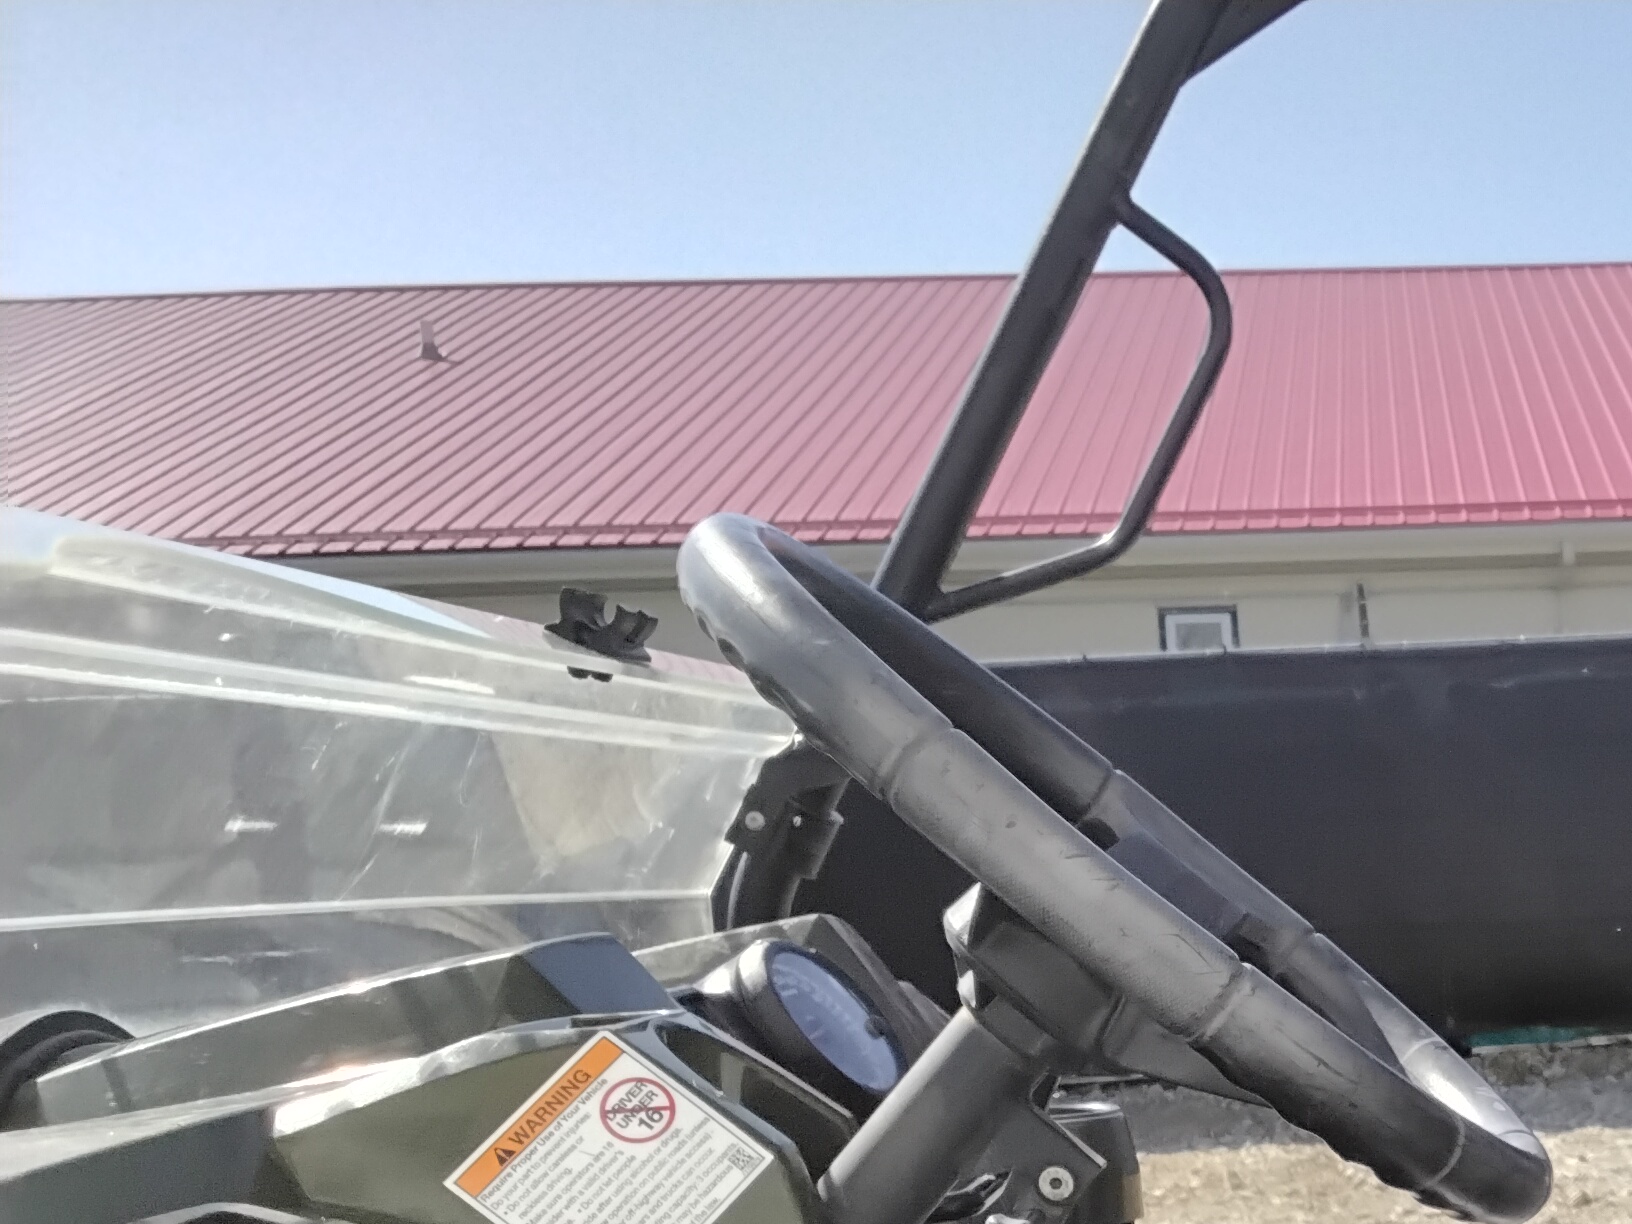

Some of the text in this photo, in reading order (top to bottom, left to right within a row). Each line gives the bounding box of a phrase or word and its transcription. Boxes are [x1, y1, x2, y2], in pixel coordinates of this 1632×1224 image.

[508, 1069, 591, 1144] WARNING
[604, 1079, 647, 1120] DRIVER
[617, 1090, 657, 1127] UNDER
[638, 1106, 663, 1129] 16
[480, 1078, 607, 1203] Require Proper Use of Your Vehicle
